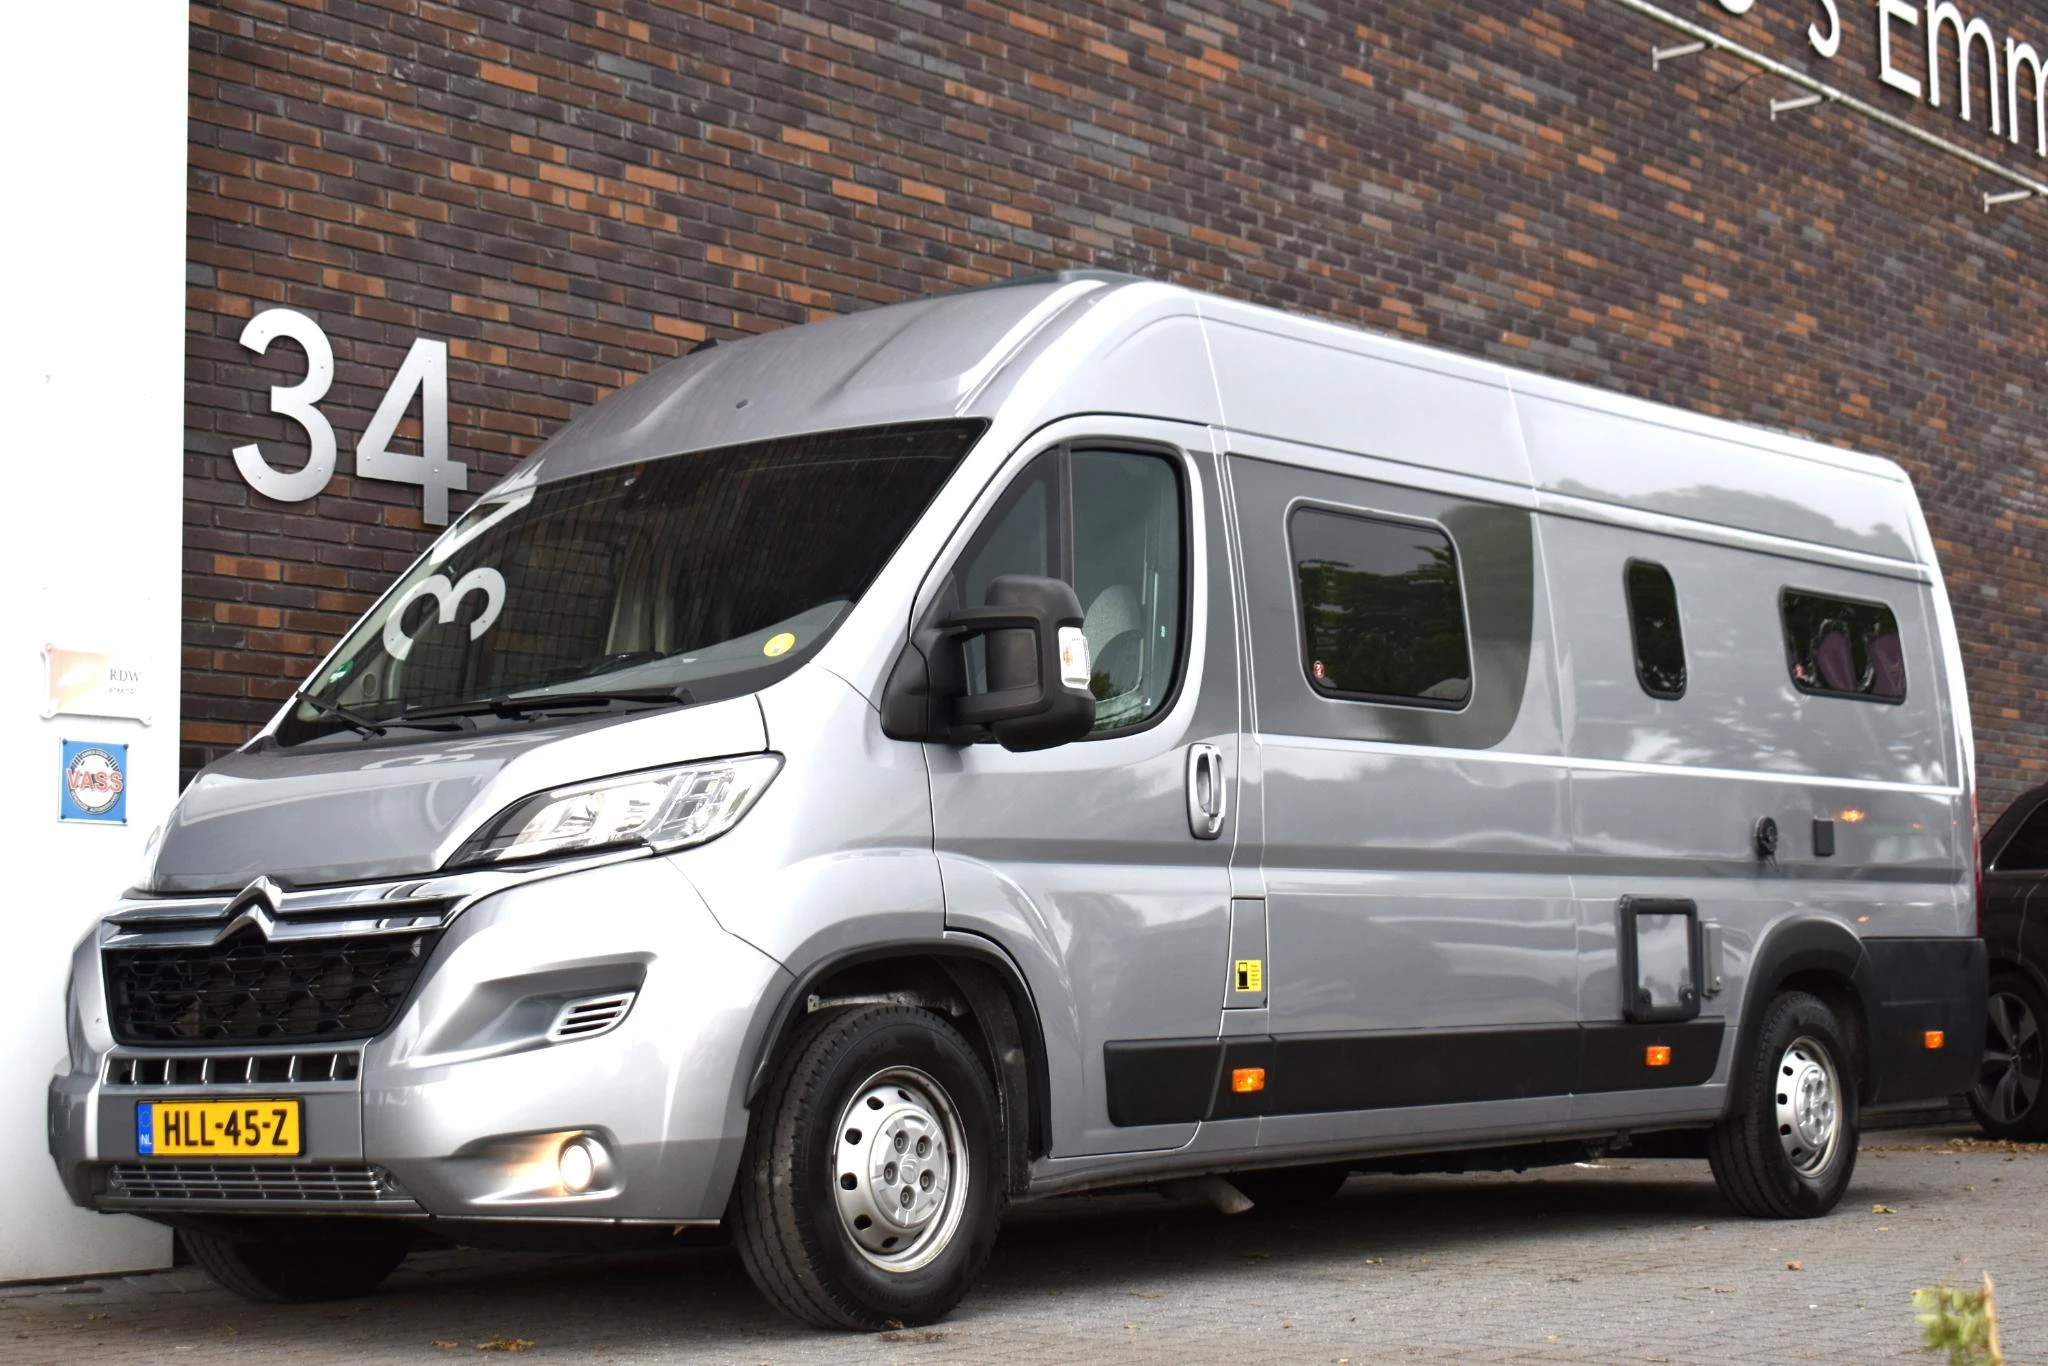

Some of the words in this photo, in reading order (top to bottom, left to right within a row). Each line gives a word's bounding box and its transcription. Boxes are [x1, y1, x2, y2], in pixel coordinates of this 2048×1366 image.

[232, 308, 467, 526] 34
[109, 668, 142, 683] RDW
[66, 768, 123, 794] VASS
[141, 1134, 153, 1145] NL
[164, 1109, 288, 1146] HLL-45-Z
